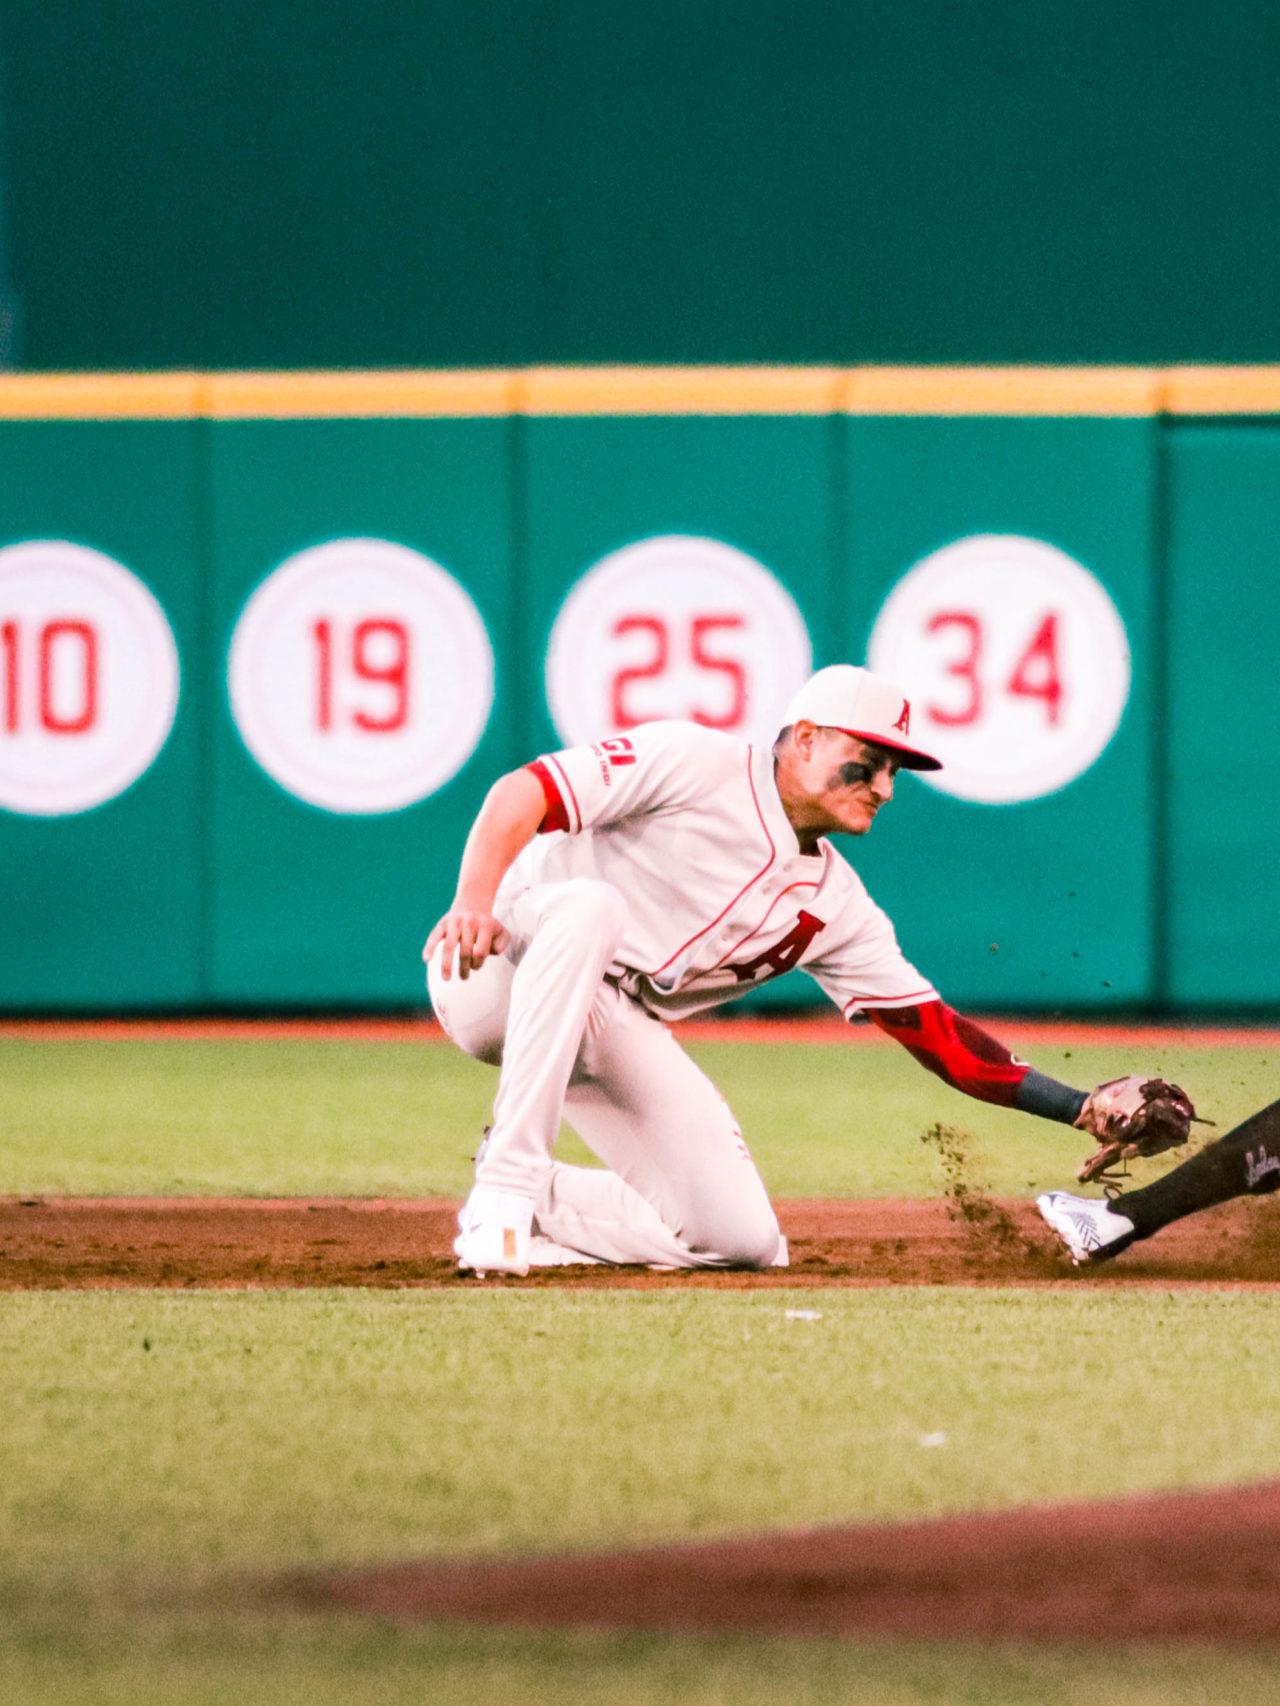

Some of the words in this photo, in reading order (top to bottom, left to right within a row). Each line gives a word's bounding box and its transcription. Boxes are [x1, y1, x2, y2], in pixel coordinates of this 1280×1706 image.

[2, 618, 98, 734] 10
[313, 618, 410, 733] 19
[611, 616, 750, 729] 25
[895, 699, 911, 736] A
[926, 609, 1063, 729] 34
[719, 909, 826, 981] A
